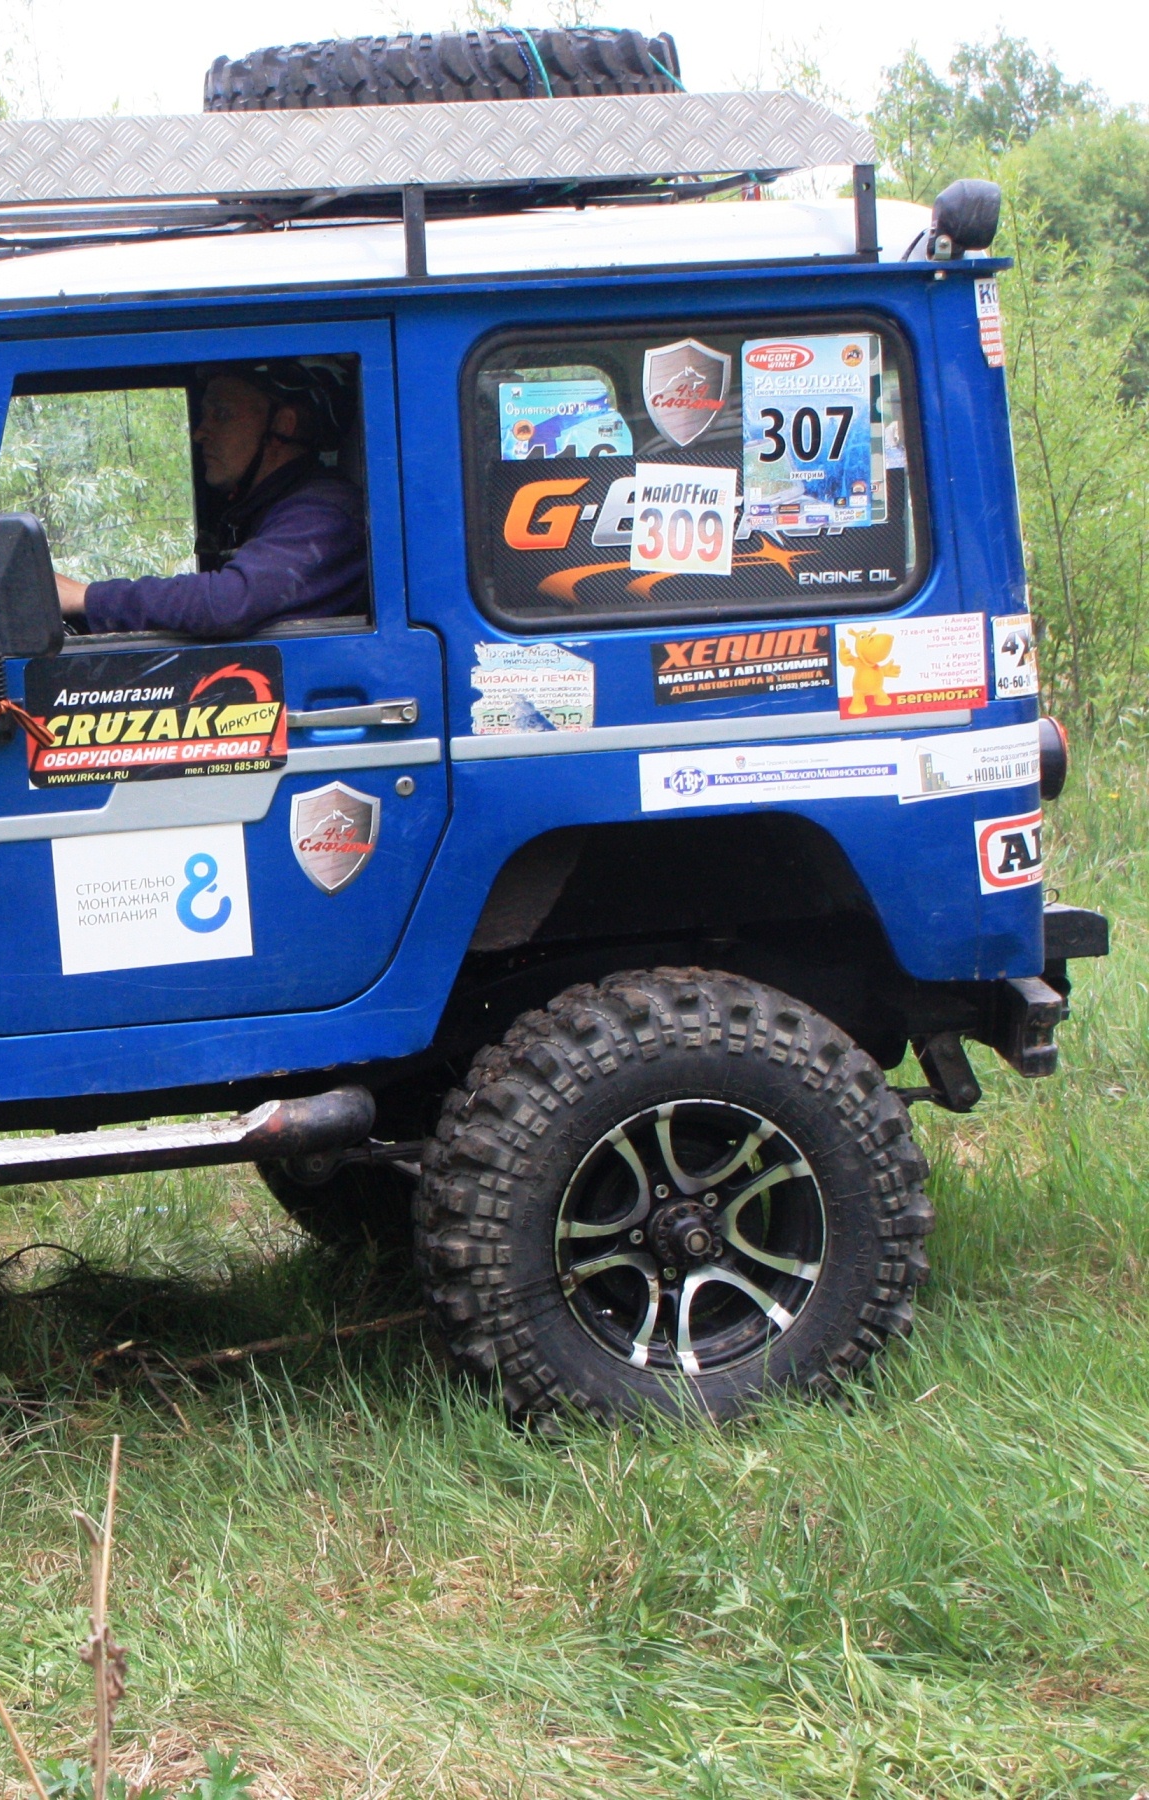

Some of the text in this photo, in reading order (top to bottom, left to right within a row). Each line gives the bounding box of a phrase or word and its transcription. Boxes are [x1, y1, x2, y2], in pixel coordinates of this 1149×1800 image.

[748, 353, 798, 363] KINGONE
[767, 361, 796, 369] WINCH
[754, 373, 862, 389] РАСКОЛОТКА
[759, 405, 853, 463] 307
[790, 472, 825, 481] экстрим
[638, 507, 724, 562] 309
[798, 568, 897, 585] ENGINE OIL
[474, 674, 528, 685] ДИЗАЙН
[542, 673, 590, 683] ПЕЧАТЬ
[659, 658, 829, 684] МАСЛА И АВТОХИМИЯ
[670, 684, 695, 695] ДЛЯ
[698, 676, 763, 691] АВТОСПОРТА
[766, 675, 774, 683] И
[53, 686, 175, 707] Автомагазин
[46, 705, 219, 747] CRUZAK
[219, 705, 277, 734] ИРКУТСК
[43, 740, 262, 768] ОБОРУДОВАНИЕ OFF-ROAD
[980, 754, 1000, 764] Фонд
[47, 771, 130, 784] WWW.IRK4x4.RU
[184, 760, 271, 776] тел. (3952) 685-890
[974, 760, 1012, 783] НОВЫЙ
[75, 875, 176, 896] СТРОИТЕЛЬНО
[77, 891, 169, 911] МОНТАЖНАЯ
[78, 908, 158, 927] КОМПАНИЯ
